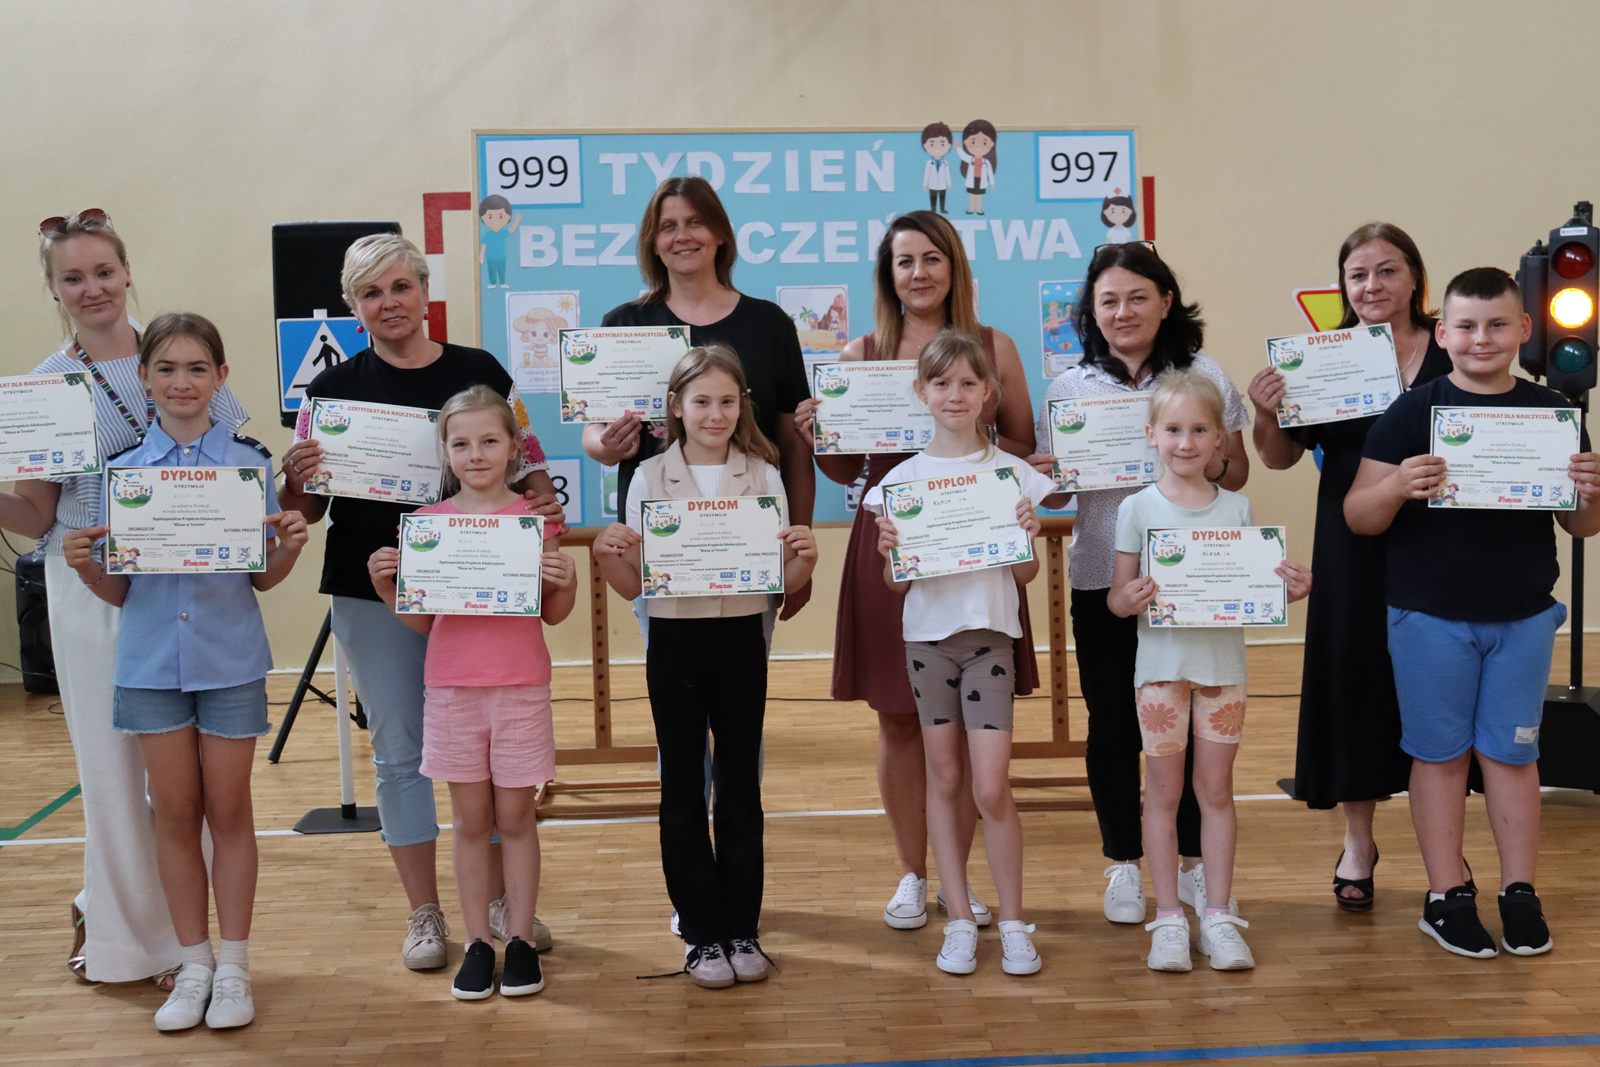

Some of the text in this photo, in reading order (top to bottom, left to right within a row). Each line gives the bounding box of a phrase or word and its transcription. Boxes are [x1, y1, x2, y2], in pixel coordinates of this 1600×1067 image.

[498, 155, 569, 190] 999
[598, 139, 896, 195] TYDZIEŃ
[1050, 151, 1118, 183] 997
[1308, 332, 1352, 346] DYPLOM
[160, 470, 217, 481] DYPLOM
[928, 474, 977, 491] DYPLOM
[688, 500, 738, 511] DYPLOM
[448, 518, 500, 529] DYPLOM
[1192, 530, 1242, 541] DYPLOM
